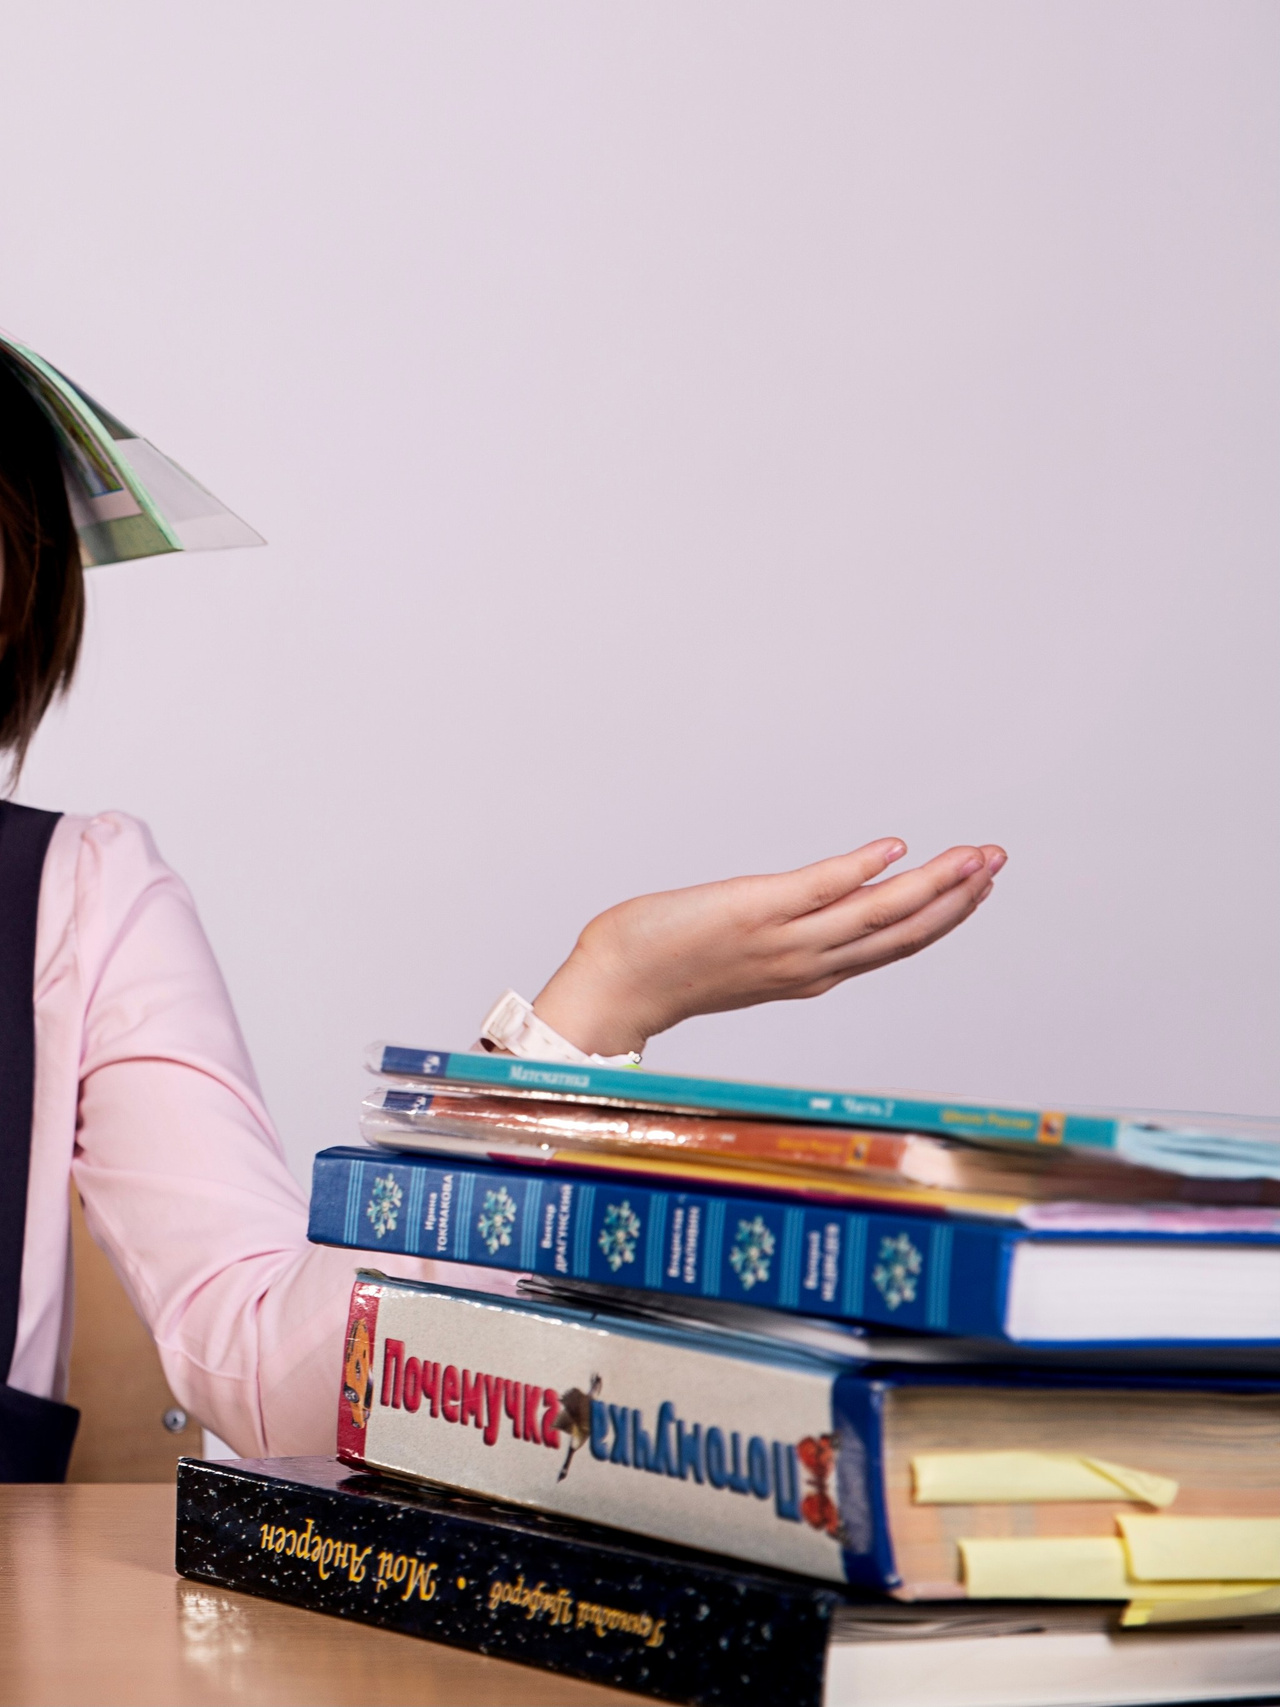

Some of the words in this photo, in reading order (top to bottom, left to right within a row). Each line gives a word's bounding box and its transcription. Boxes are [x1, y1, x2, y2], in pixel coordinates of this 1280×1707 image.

[509, 1065, 590, 1088] Математика
[424, 1192, 438, 1231] Ирина
[437, 1174, 453, 1252] ТОКМАКОВА
[540, 1204, 556, 1249] Виктор
[555, 1184, 573, 1273] ДРАГУНСКИЙ
[380, 1337, 562, 1449] Почемучка
[588, 1398, 802, 1522] Потомучка
[259, 1518, 372, 1583] Андерсен
[375, 1551, 439, 1602] Мой
[488, 1575, 573, 1627] Цыферов
[575, 1600, 667, 1649] Геннадий
